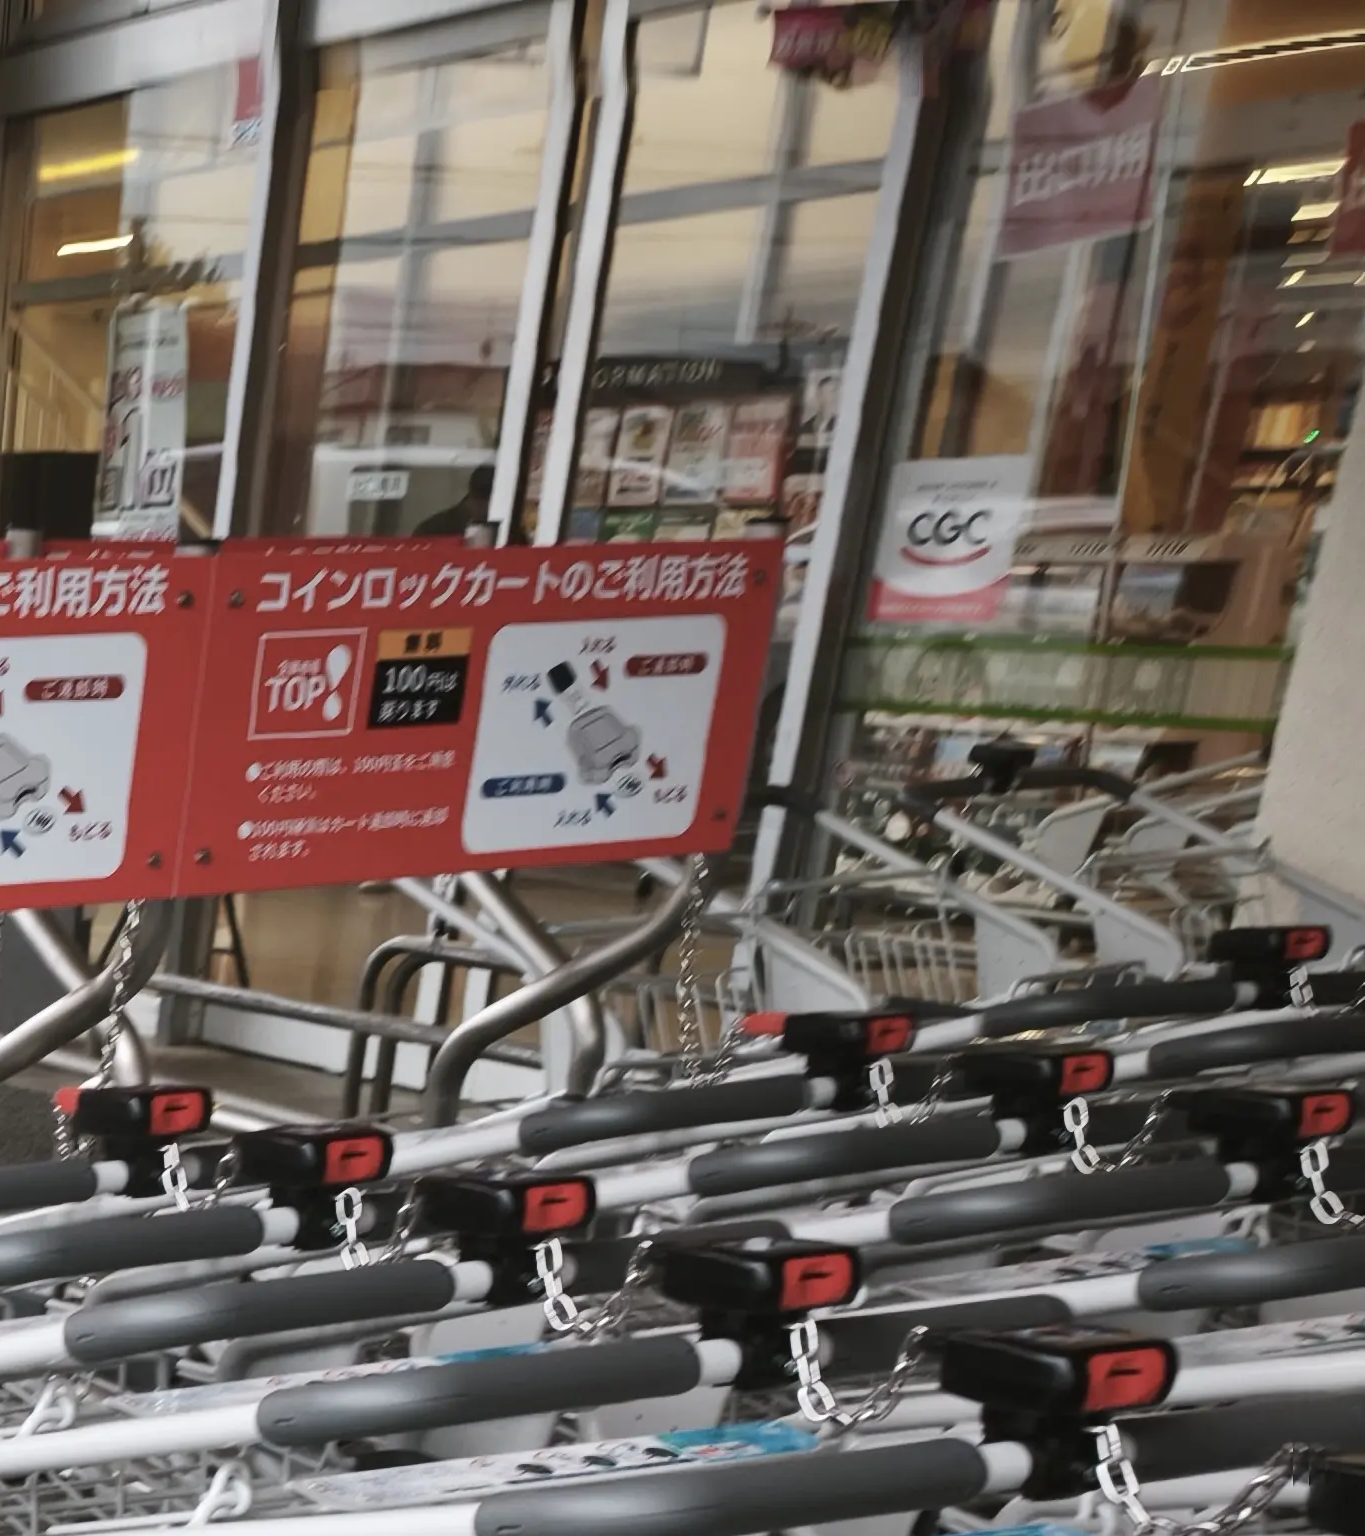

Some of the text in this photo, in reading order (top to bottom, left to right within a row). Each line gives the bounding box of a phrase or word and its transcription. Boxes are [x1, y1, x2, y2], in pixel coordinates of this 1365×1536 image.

[906, 508, 994, 546] CGC
[256, 552, 750, 612] コインロックカートのご利用方法
